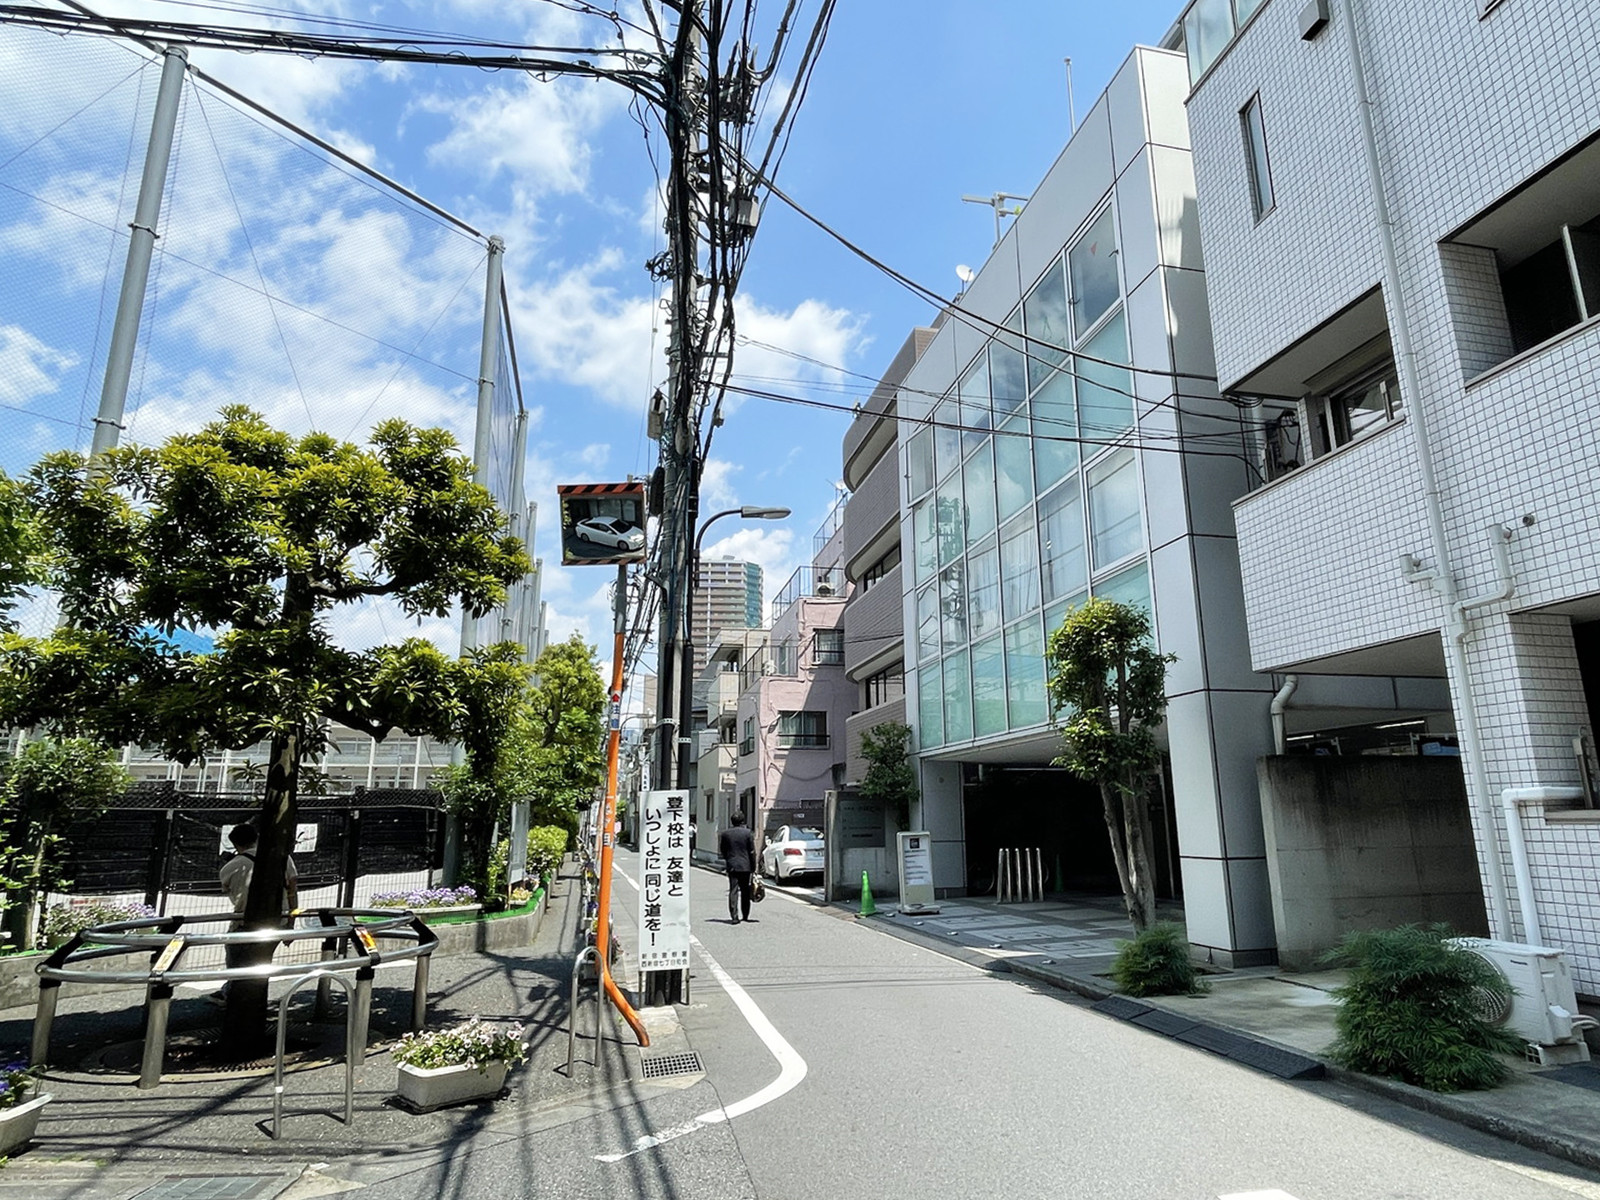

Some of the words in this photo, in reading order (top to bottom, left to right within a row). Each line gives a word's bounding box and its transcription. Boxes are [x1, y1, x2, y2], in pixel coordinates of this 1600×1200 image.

[666, 796, 684, 849] 登下校は
[666, 856, 684, 897] 友達と
